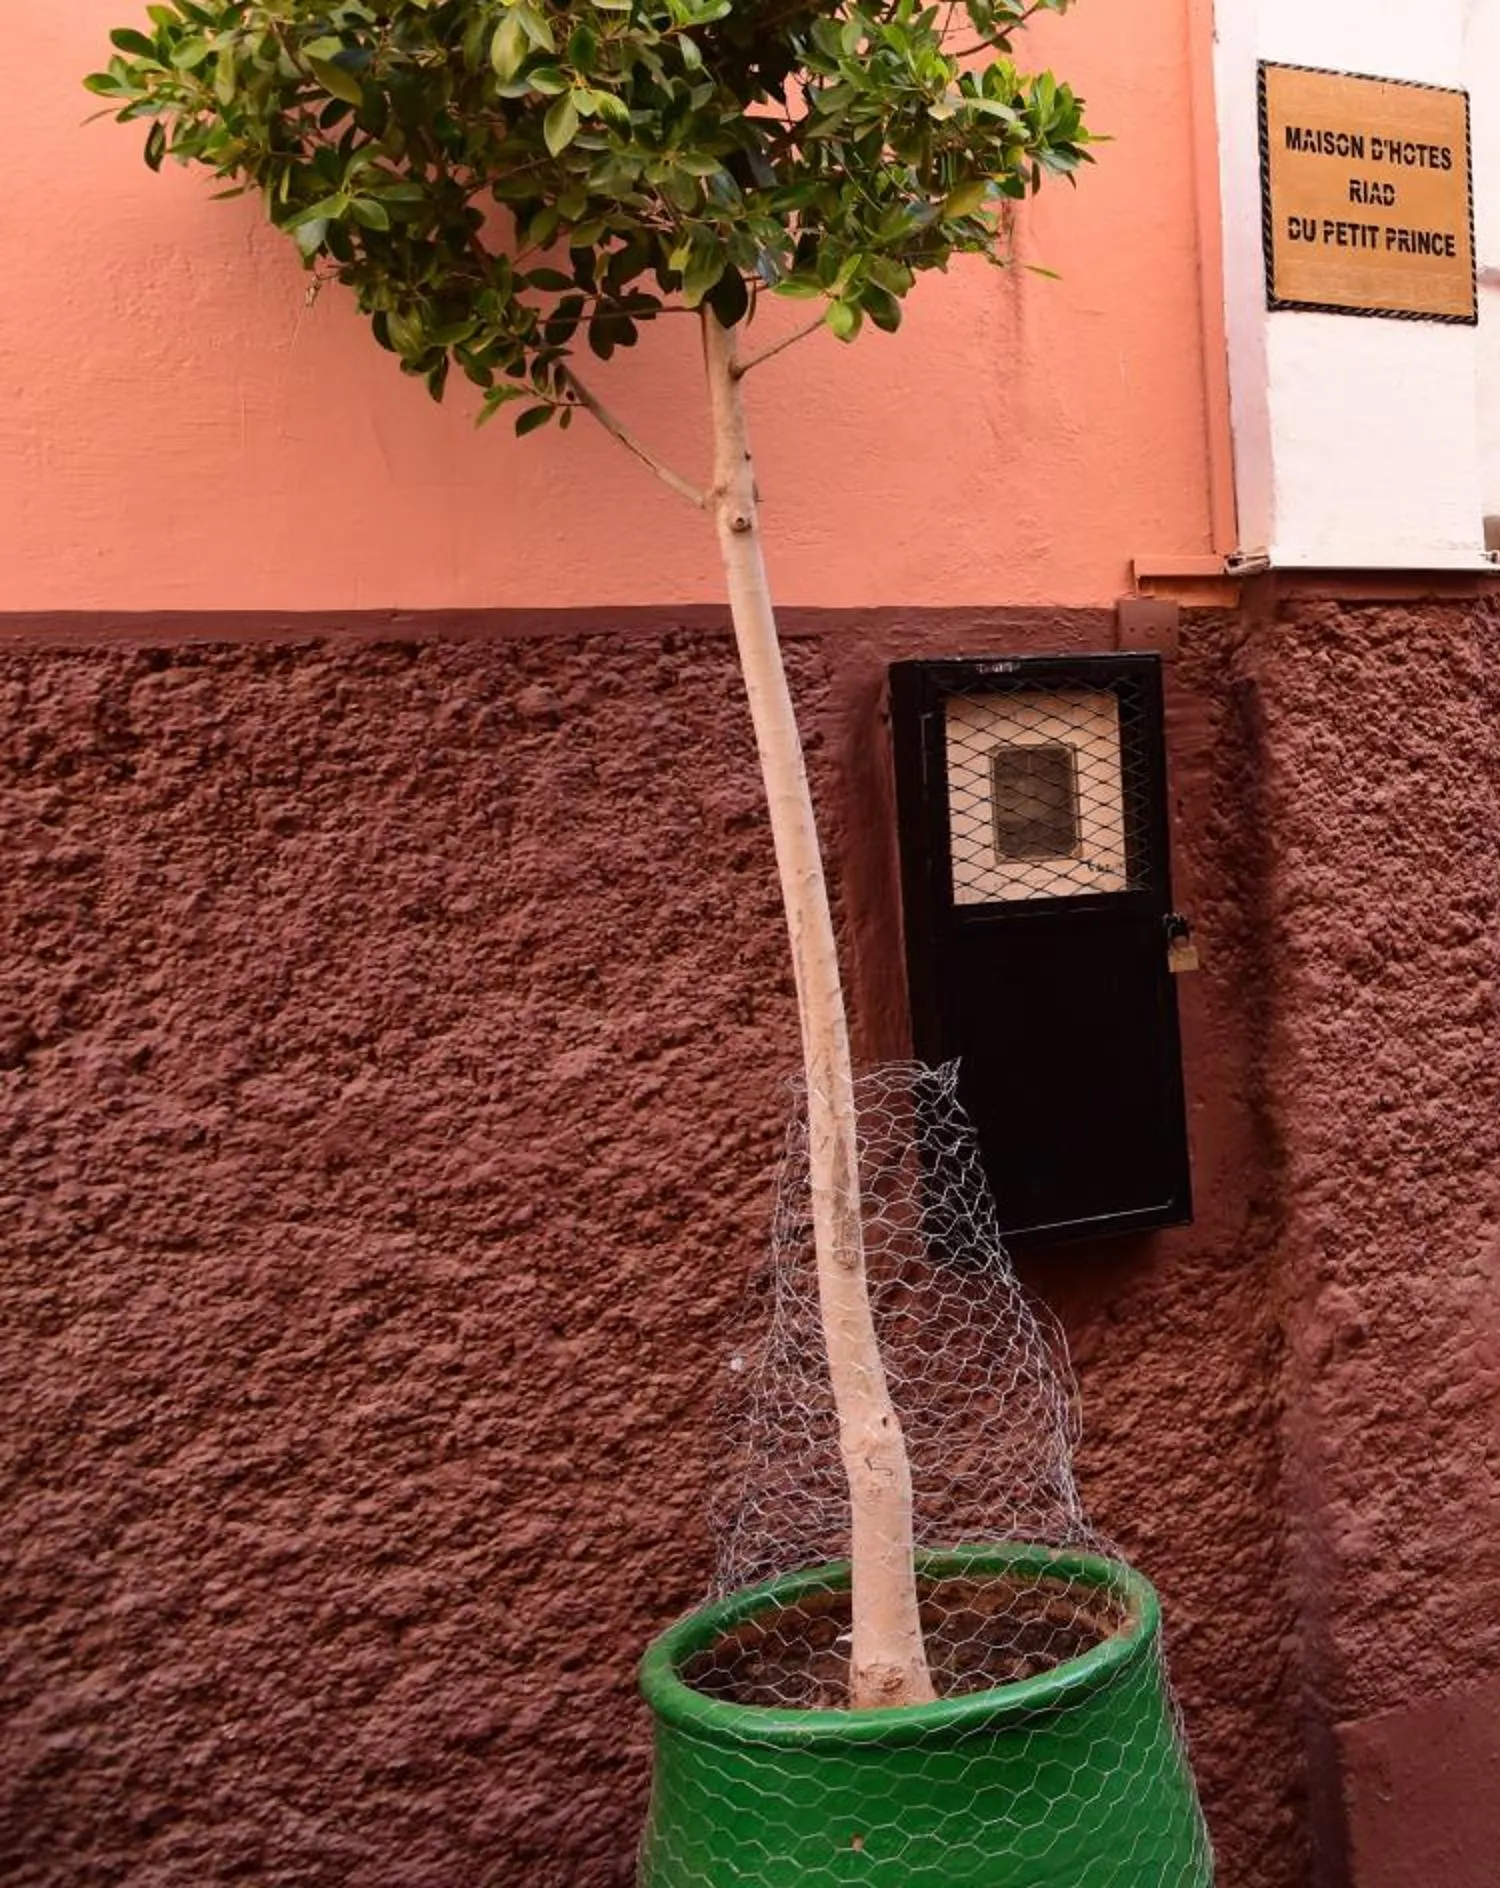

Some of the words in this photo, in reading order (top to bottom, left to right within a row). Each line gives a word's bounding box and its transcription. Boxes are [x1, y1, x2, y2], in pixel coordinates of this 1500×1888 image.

[1285, 126, 1365, 158] MAISON
[1371, 137, 1452, 171] D'HOTES
[1349, 179, 1395, 207] RIAD
[1288, 217, 1316, 242] DU
[1323, 221, 1380, 249] PETIT
[1385, 228, 1457, 257] PRINCE
